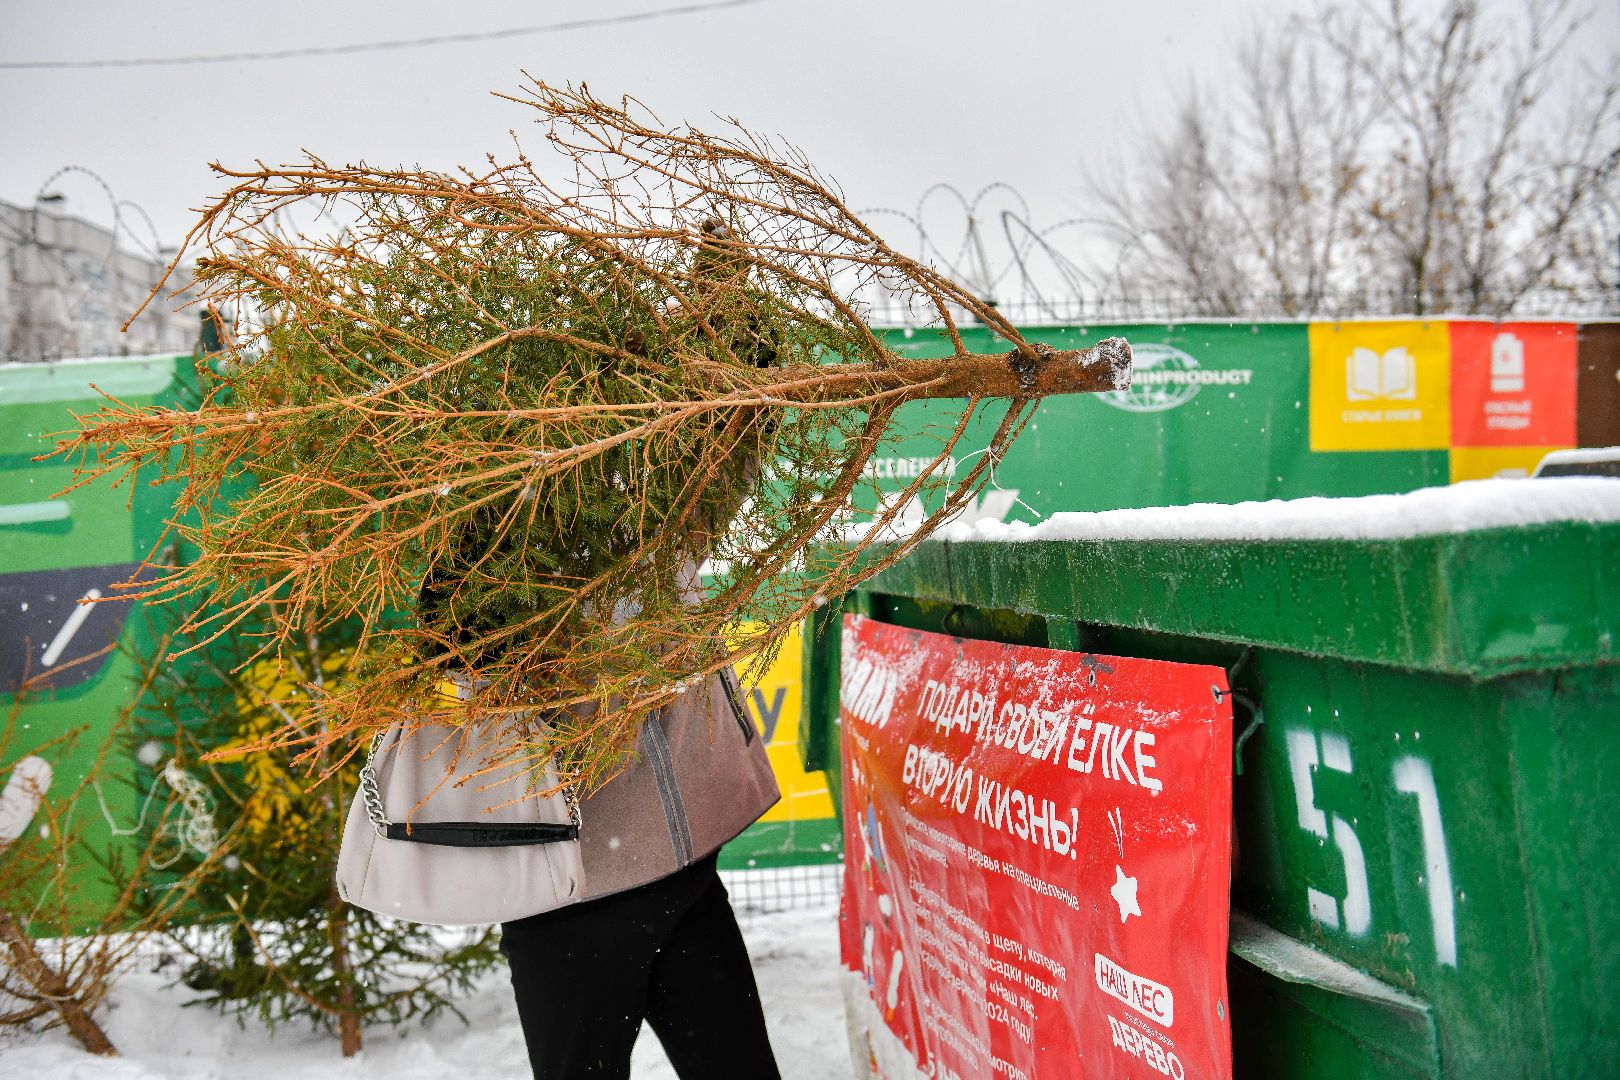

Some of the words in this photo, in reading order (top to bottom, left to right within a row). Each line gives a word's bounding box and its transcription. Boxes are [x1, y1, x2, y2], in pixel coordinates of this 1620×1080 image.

[1131, 369, 1252, 385] MINPRODUCT
[917, 679, 997, 744] ПОДАРИ
[1068, 703, 1164, 792] ЁЛКЕ
[903, 744, 973, 814] ВТОРУЮ
[974, 774, 1079, 861] ЖИЗНЬ!
[1286, 726, 1457, 968] 51
[967, 845, 1000, 873] деревья
[1001, 861, 1015, 877] на
[1015, 867, 1080, 911] специальные
[993, 933, 1027, 962] щепу,
[1028, 948, 1067, 982] которая
[1024, 972, 1059, 1000] новых
[989, 980, 1018, 1006] «Наш
[1100, 960, 1129, 999] НАШ
[1132, 980, 1165, 1017] ЛЕС
[1106, 1013, 1185, 1080] ДЕРЕВО
